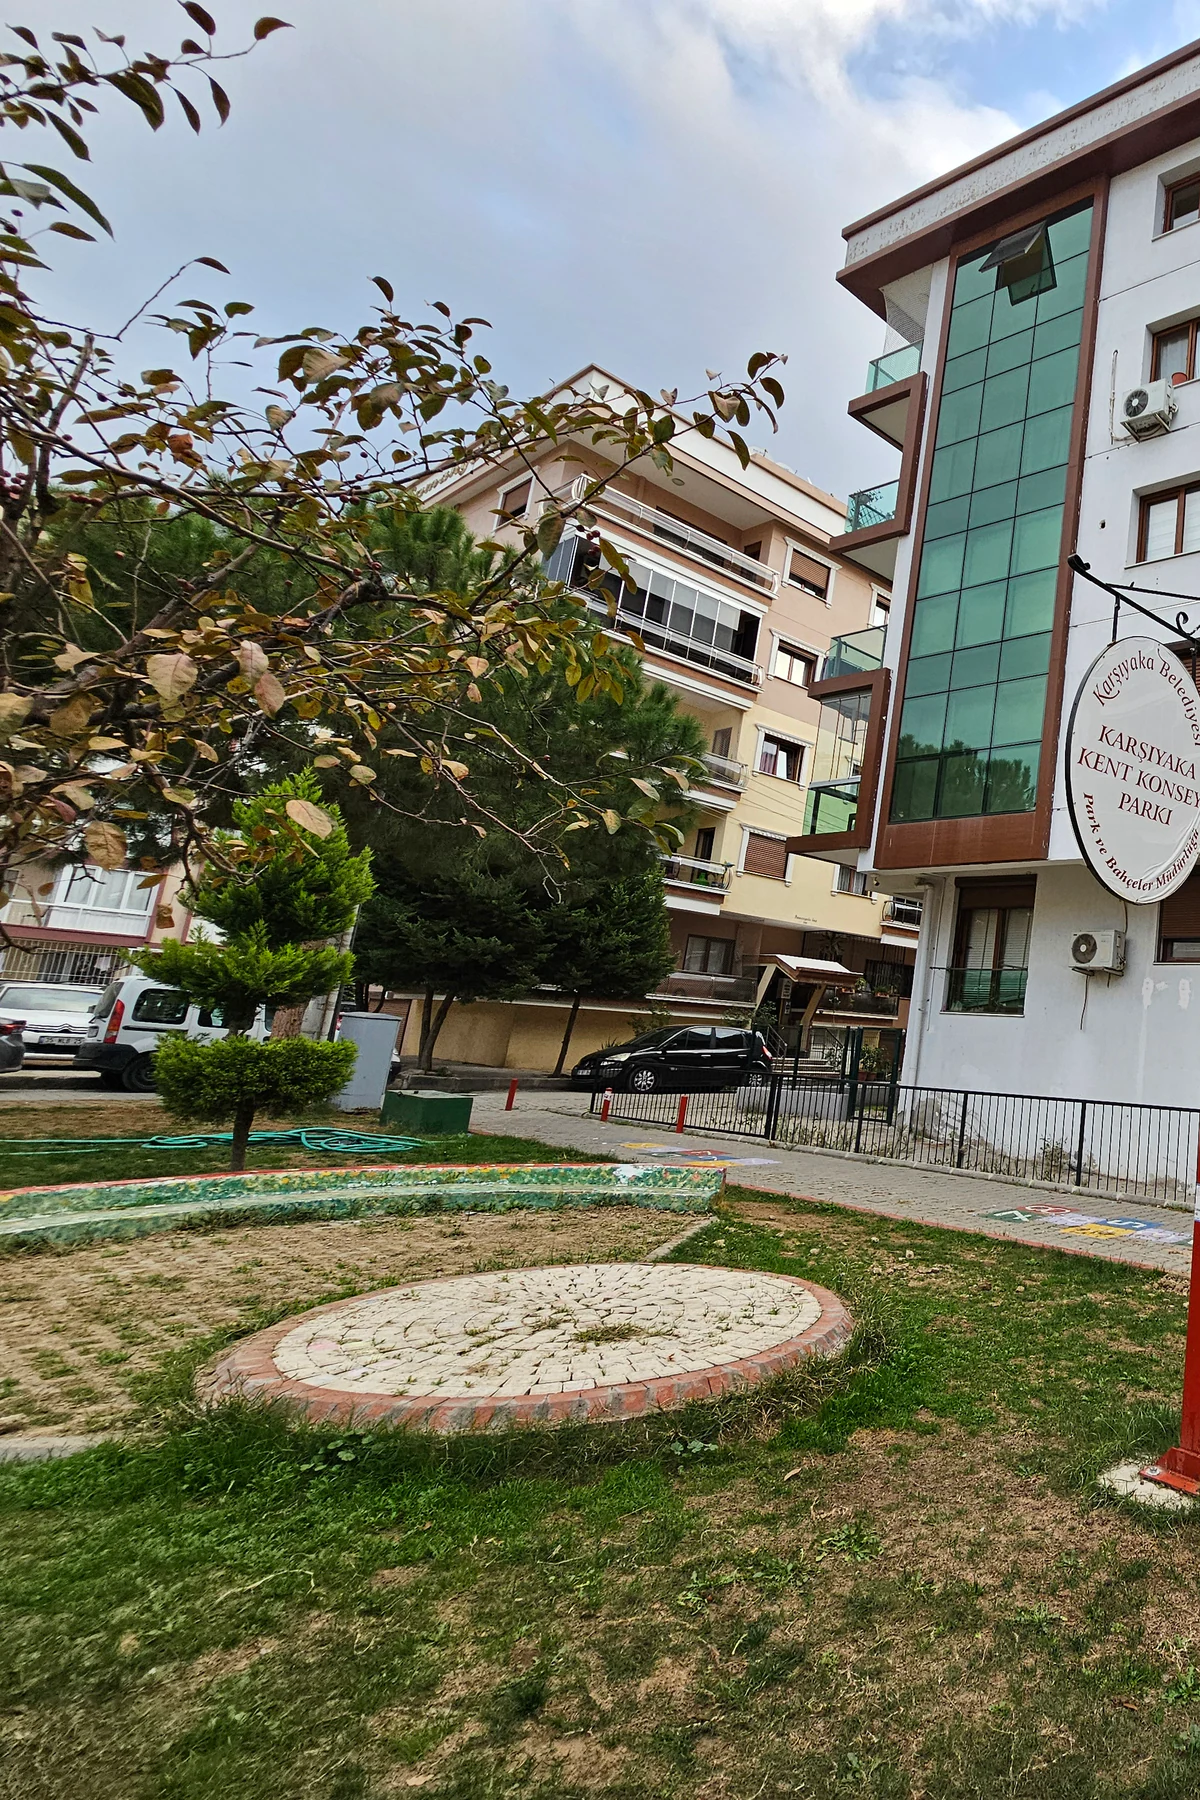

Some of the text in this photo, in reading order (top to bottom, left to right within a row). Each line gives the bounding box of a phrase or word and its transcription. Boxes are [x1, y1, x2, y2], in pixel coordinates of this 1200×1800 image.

[1093, 650, 1154, 707] Karşıyaka
[1077, 746, 1134, 782] KENT
[1098, 724, 1196, 780] KARŞIYAKA
[1118, 791, 1173, 825] PARKI
[1083, 792, 1199, 891] Park ve Bahçeler Müdürlüğü
